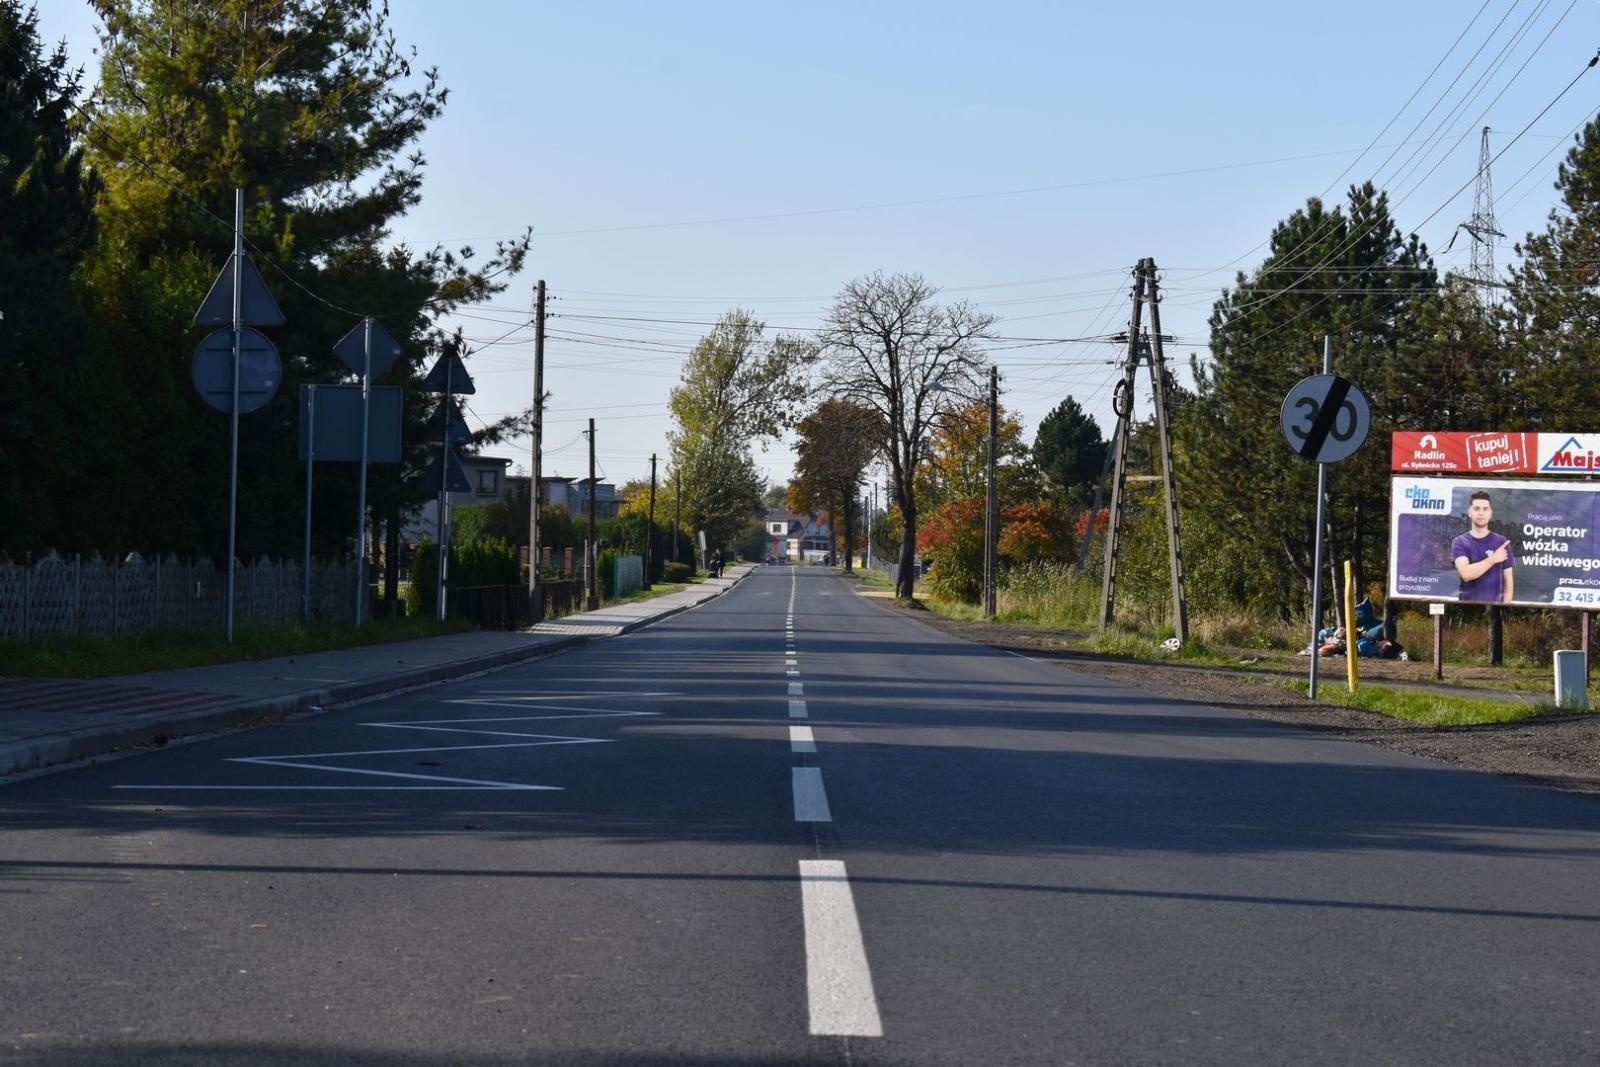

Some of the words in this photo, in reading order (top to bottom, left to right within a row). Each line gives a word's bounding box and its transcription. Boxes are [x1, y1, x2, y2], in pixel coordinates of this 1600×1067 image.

[1292, 396, 1358, 442] 30
[1474, 434, 1509, 453] kupuj
[1414, 450, 1446, 460] Radlin
[1523, 523, 1588, 539] Operator
[1522, 538, 1569, 552] wózka
[1522, 553, 1600, 572] widłowego
[1559, 591, 1572, 602] 32
[1575, 592, 1594, 603] 415
